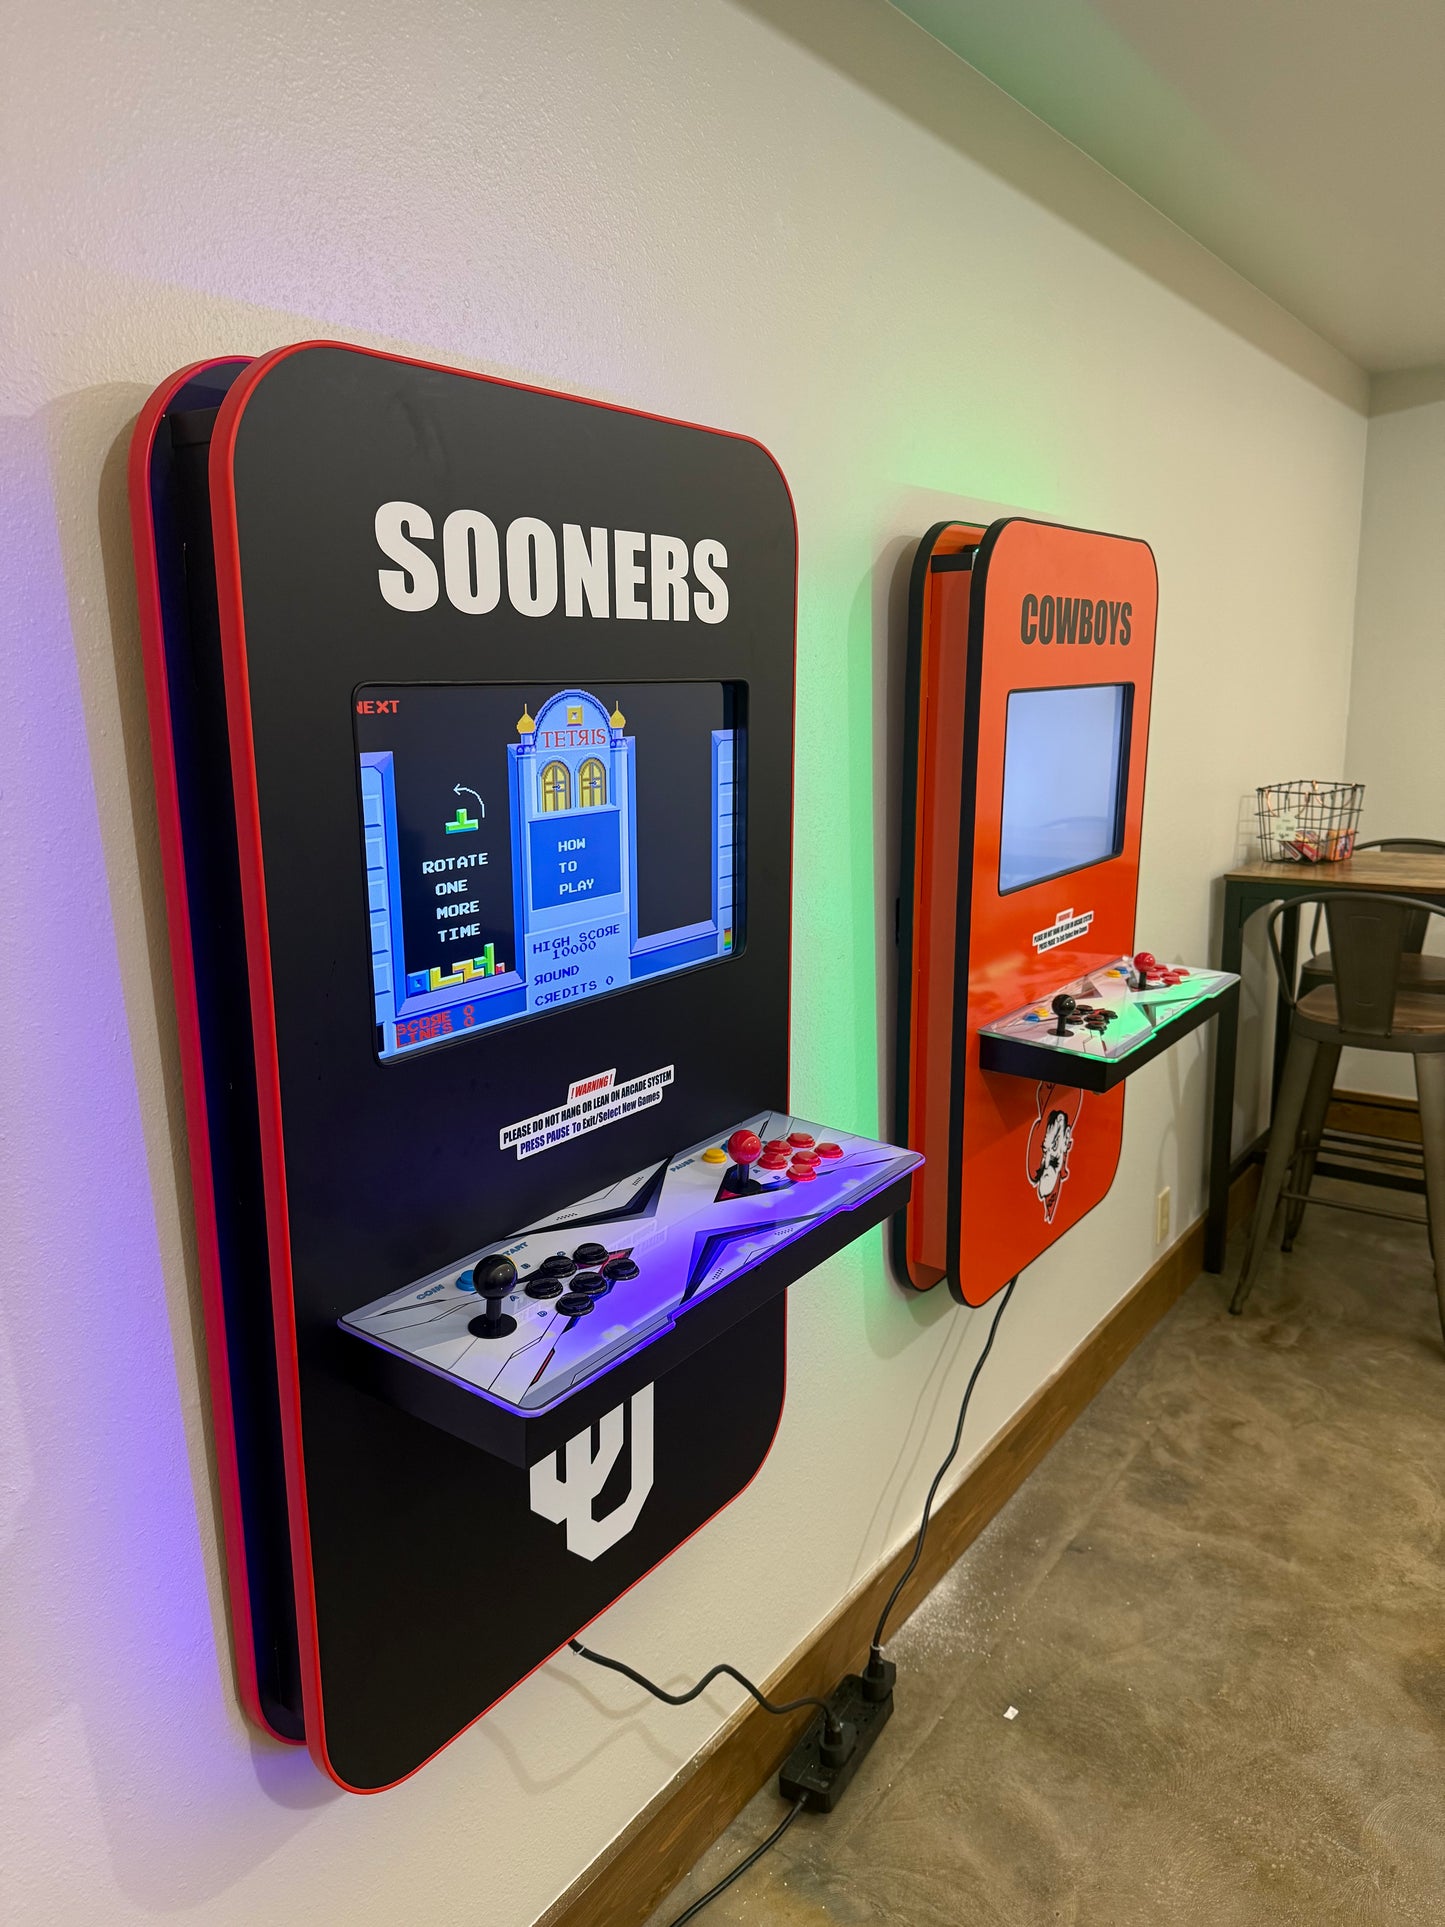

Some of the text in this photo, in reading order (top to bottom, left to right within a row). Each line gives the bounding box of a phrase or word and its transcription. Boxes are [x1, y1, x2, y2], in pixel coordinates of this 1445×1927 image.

[375, 501, 729, 624] SOONERS
[1020, 594, 1132, 645] COWBOYS
[557, 838, 586, 852] HOW
[422, 852, 488, 874] ROTATE
[559, 860, 578, 874] TO
[435, 879, 468, 896] ONE
[559, 878, 595, 895] PLAY
[436, 900, 480, 920] MORE
[437, 923, 481, 943] TIME
[533, 936, 570, 954] HIGH
[552, 941, 596, 960] 10000
[396, 1021, 453, 1049] LINES
[503, 1069, 672, 1144] PLEASE DO NOT HANG OR LEAN ON ARCADE SYSTEM
[520, 1090, 660, 1155] PRESS PAUSE To Exit/Select New Games
[670, 1158, 695, 1173] PAUSE
[502, 1241, 528, 1257] TART
[416, 1284, 445, 1300] COIN
